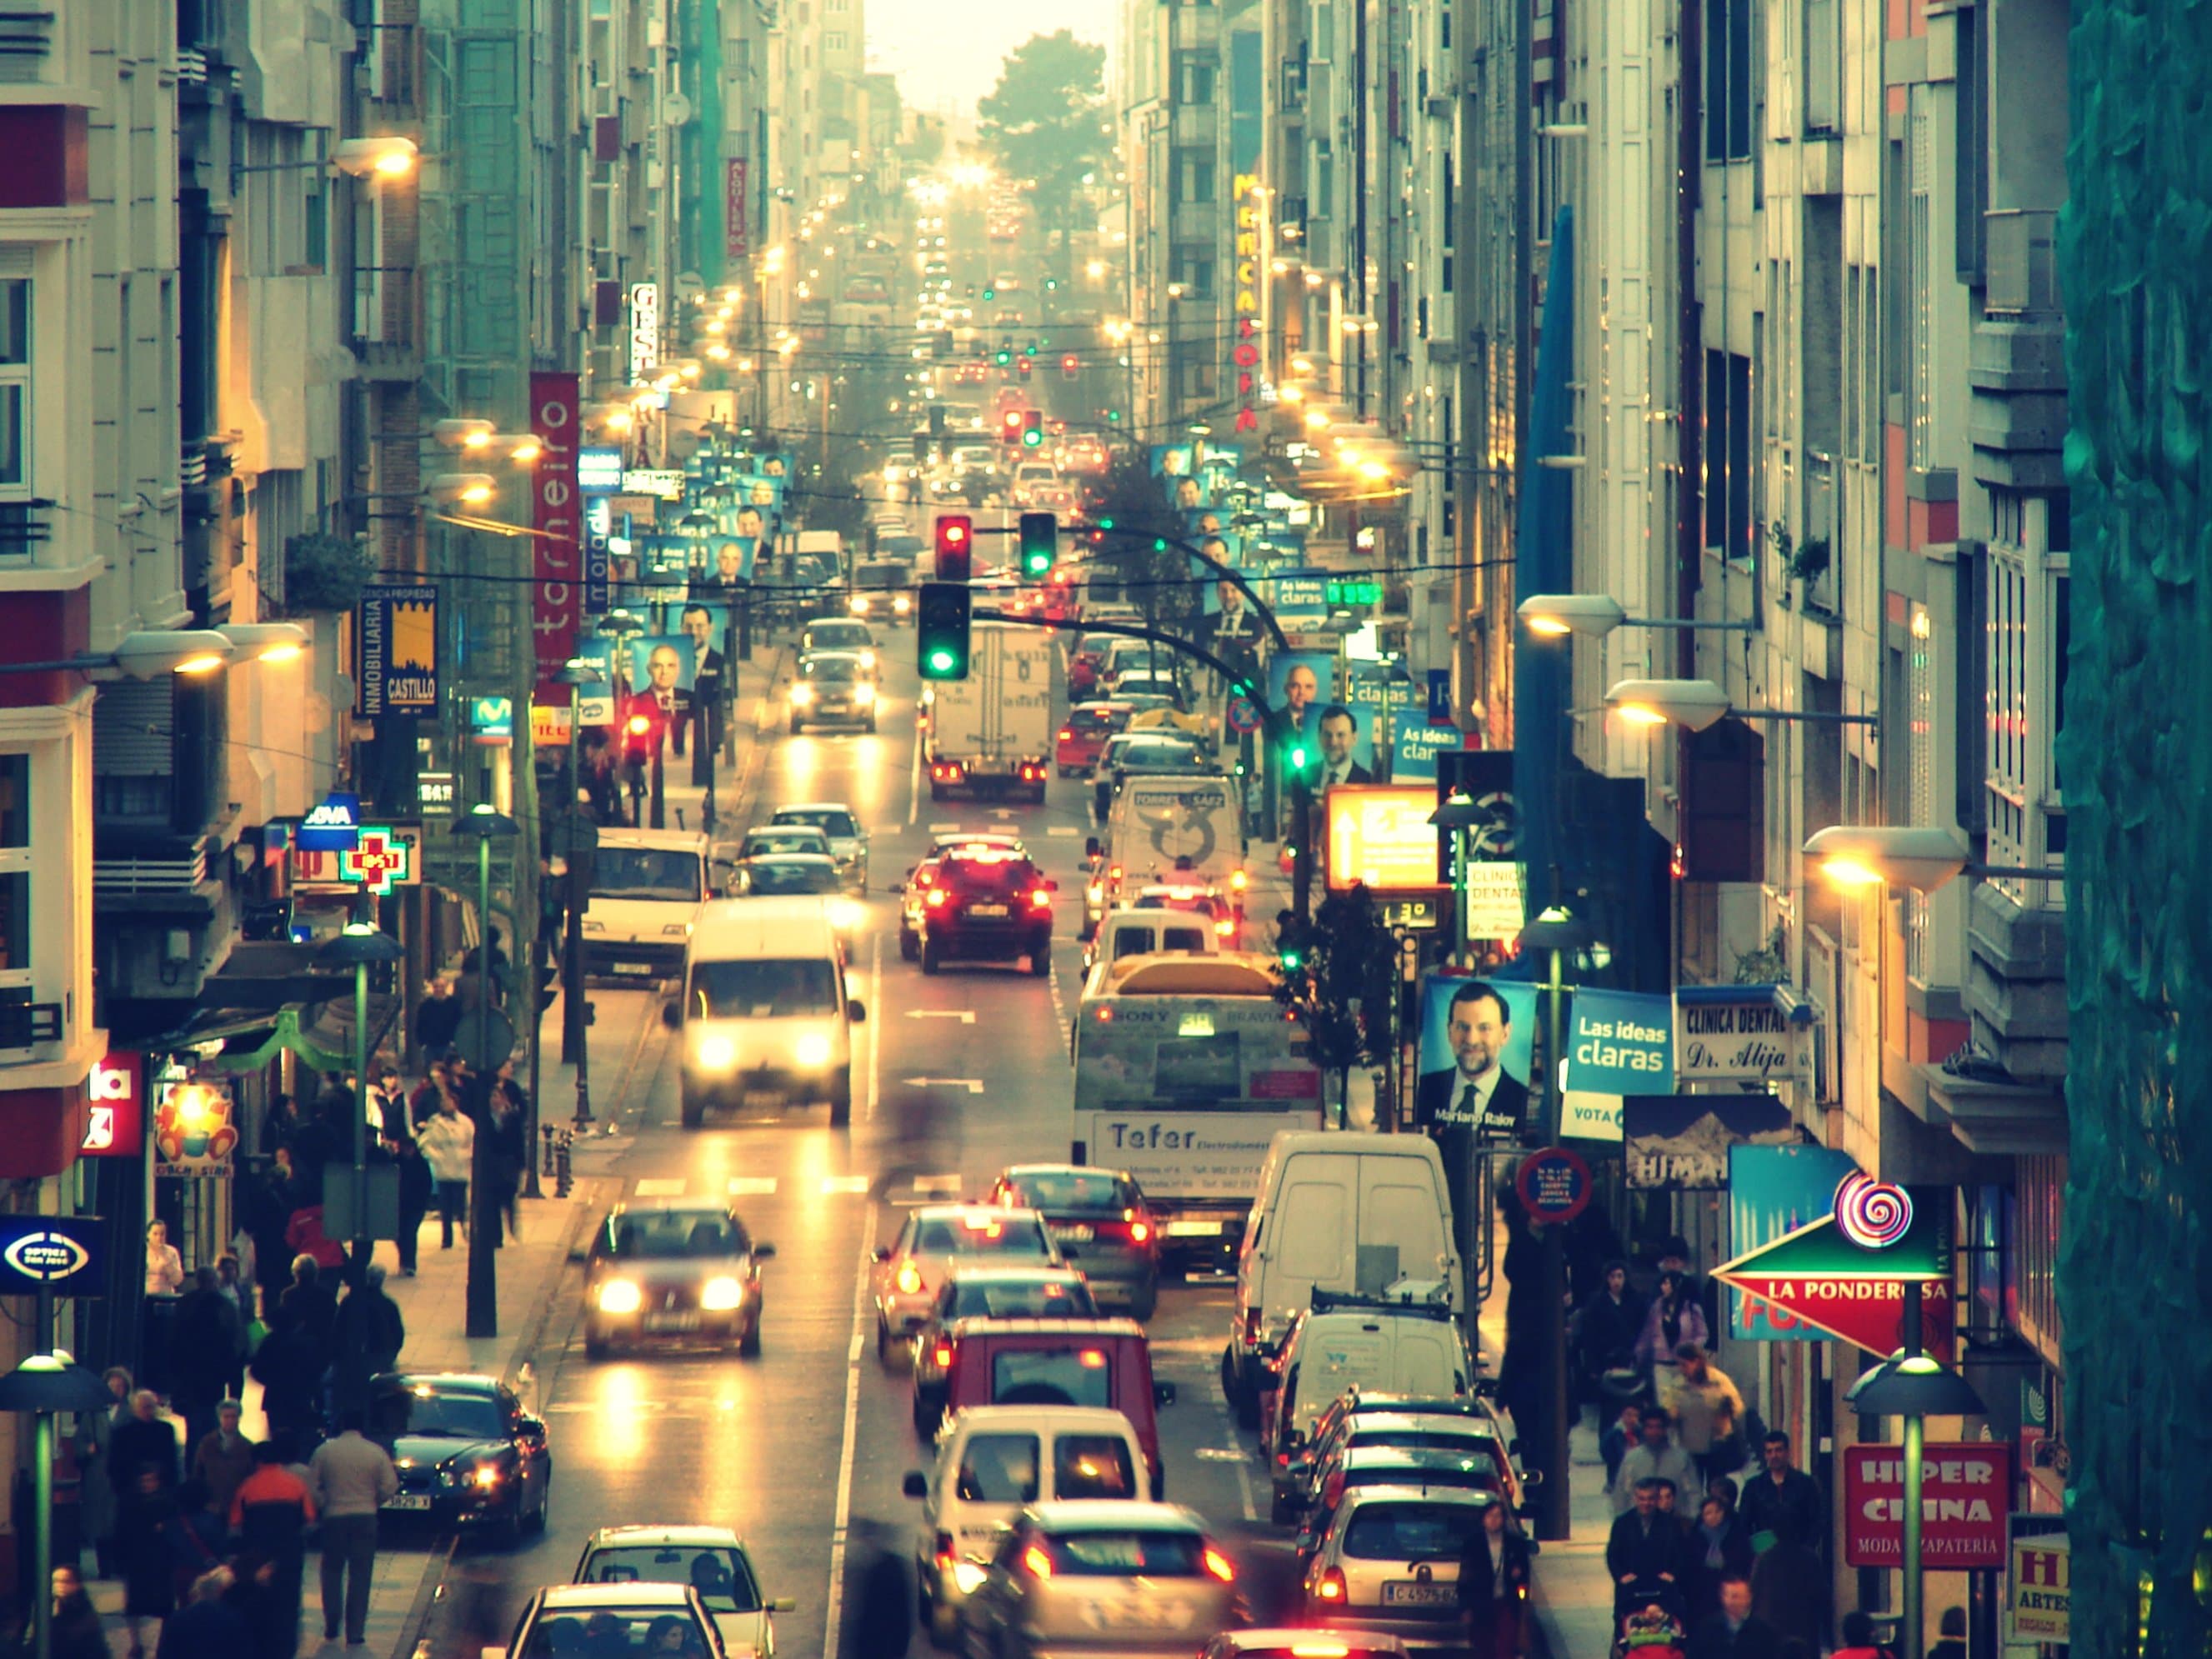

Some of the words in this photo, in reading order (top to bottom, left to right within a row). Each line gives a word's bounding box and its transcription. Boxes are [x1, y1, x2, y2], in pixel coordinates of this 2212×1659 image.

[633, 287, 655, 468] GESTRIA
[534, 402, 569, 636] torneiro
[1282, 592, 1323, 605] claras
[365, 599, 382, 714] INMOBILIARIA
[388, 677, 435, 701] CASTILLO
[1358, 687, 1409, 702] claas
[1403, 727, 1419, 742] As
[1422, 727, 1457, 744] ideas
[1403, 744, 1438, 761] clar
[305, 805, 352, 825] BVA
[1579, 1017, 1613, 1038] Las
[1615, 1020, 1667, 1043] ideas
[1686, 1007, 1734, 1034] CLINICA
[1738, 1006, 1787, 1033] DENTAL
[1576, 1040, 1664, 1072] claras
[1686, 1041, 1719, 1069] Dr.
[1728, 1042, 1787, 1076] Alija
[1434, 1108, 1483, 1125] Mariano
[1484, 1111, 1516, 1127] Rajoy
[1574, 1107, 1612, 1123] VOTA
[1109, 1122, 1198, 1150] Tefer
[1769, 1281, 1796, 1300] LA
[1858, 1538, 1901, 1554] MODA
[2019, 1590, 2071, 1612] ARTES
